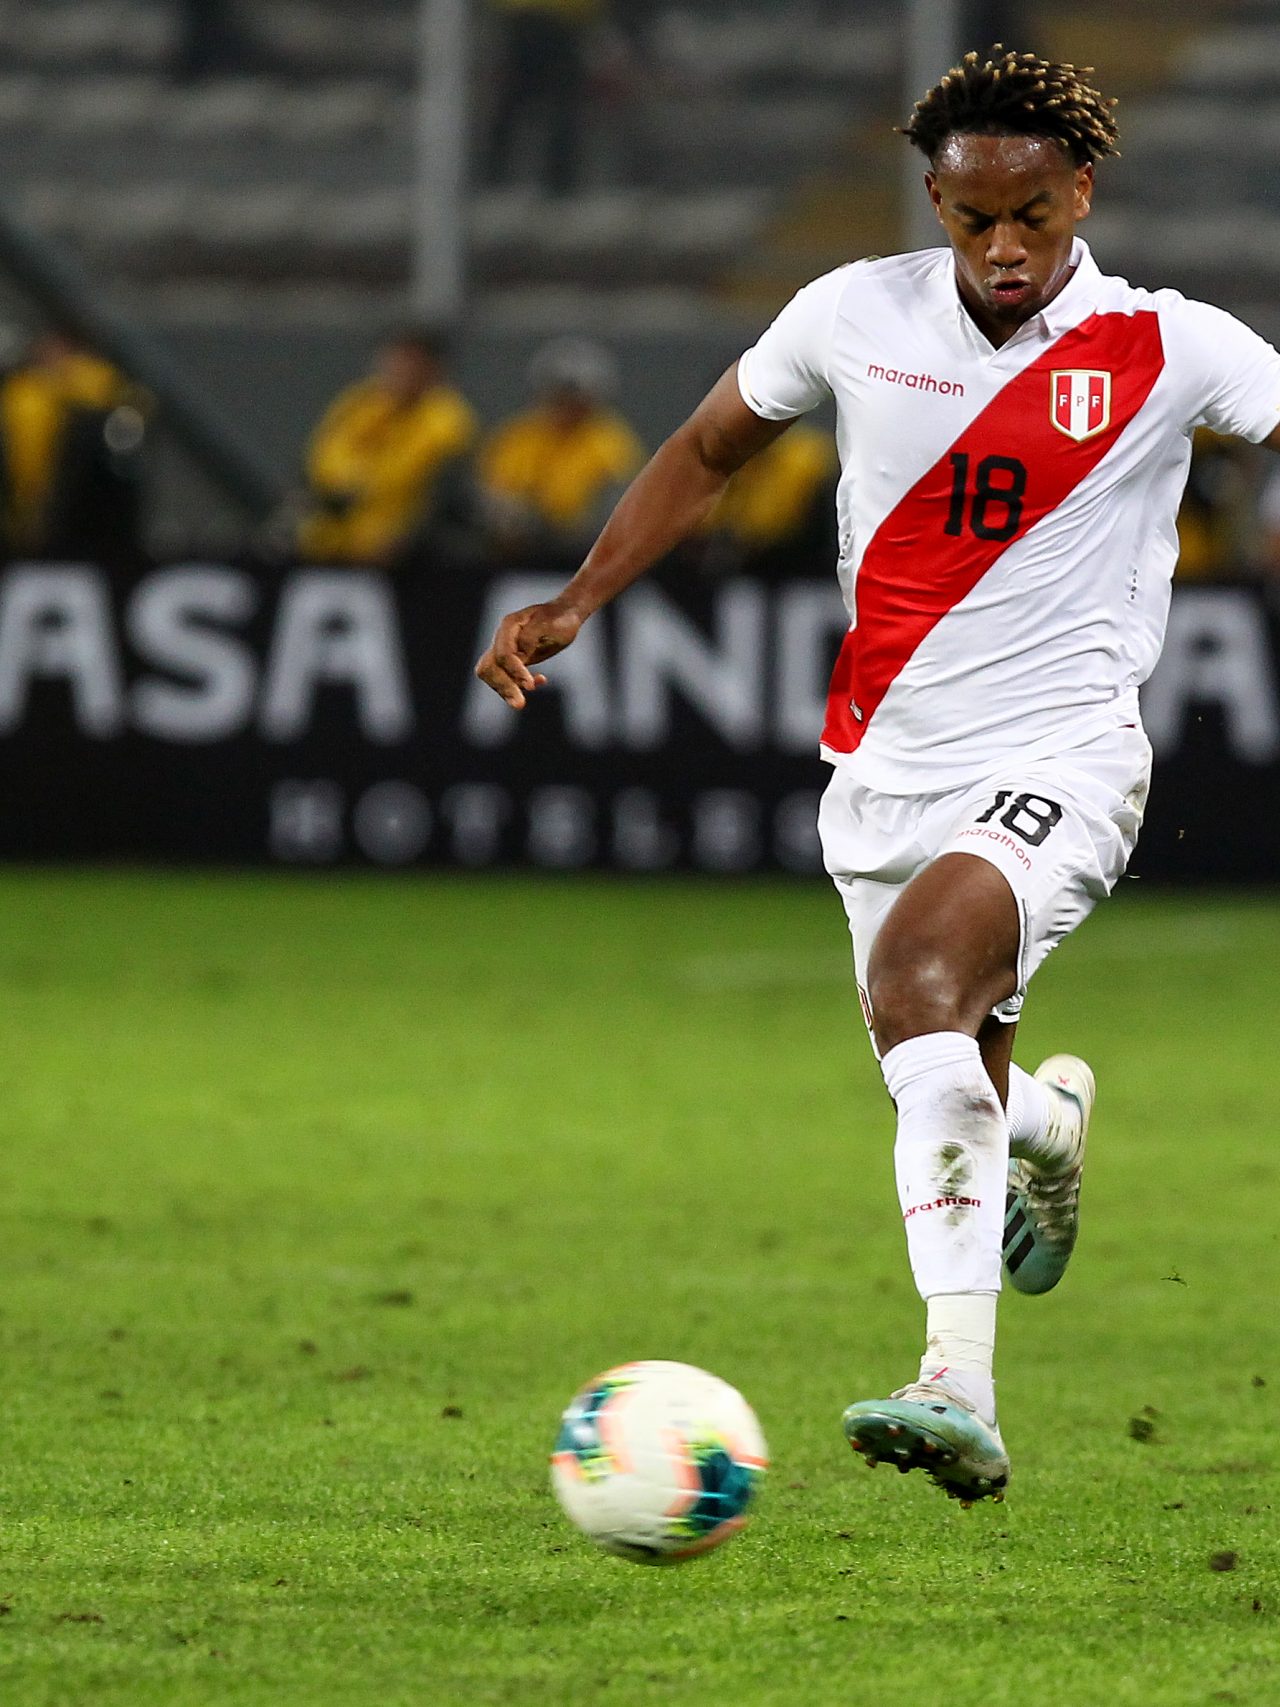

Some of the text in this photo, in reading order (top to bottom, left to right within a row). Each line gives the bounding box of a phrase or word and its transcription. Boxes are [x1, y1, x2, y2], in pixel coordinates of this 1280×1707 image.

[867, 363, 965, 397] marathon
[944, 452, 1027, 542] 18
[974, 791, 1063, 847] 18
[903, 1197, 981, 1220] arathon
